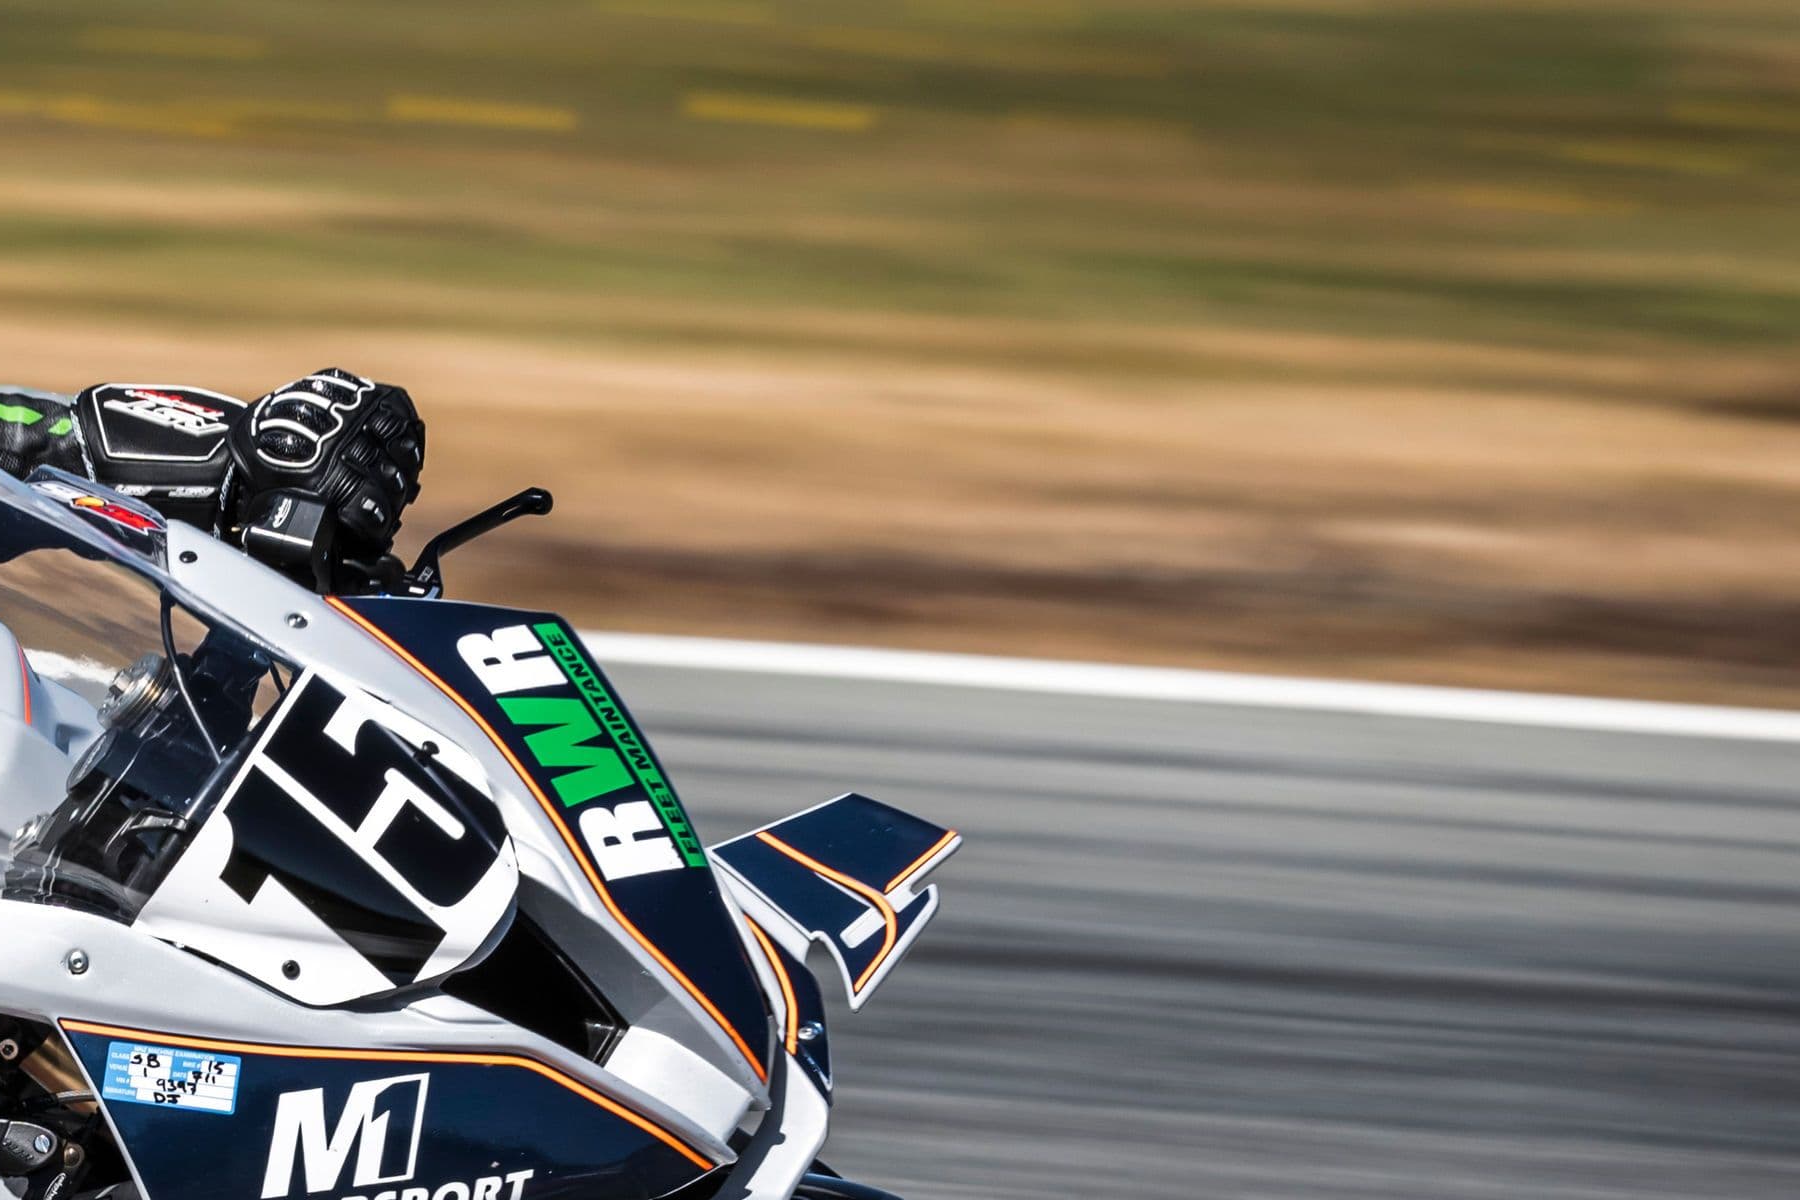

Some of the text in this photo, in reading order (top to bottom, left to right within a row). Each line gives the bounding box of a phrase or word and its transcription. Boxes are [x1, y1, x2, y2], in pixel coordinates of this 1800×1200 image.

[219, 674, 510, 986] 15
[456, 624, 686, 881] RWR
[545, 632, 701, 856] FLEET MAINTANCE
[207, 1060, 225, 1075] 15
[260, 1073, 430, 1200] M1
